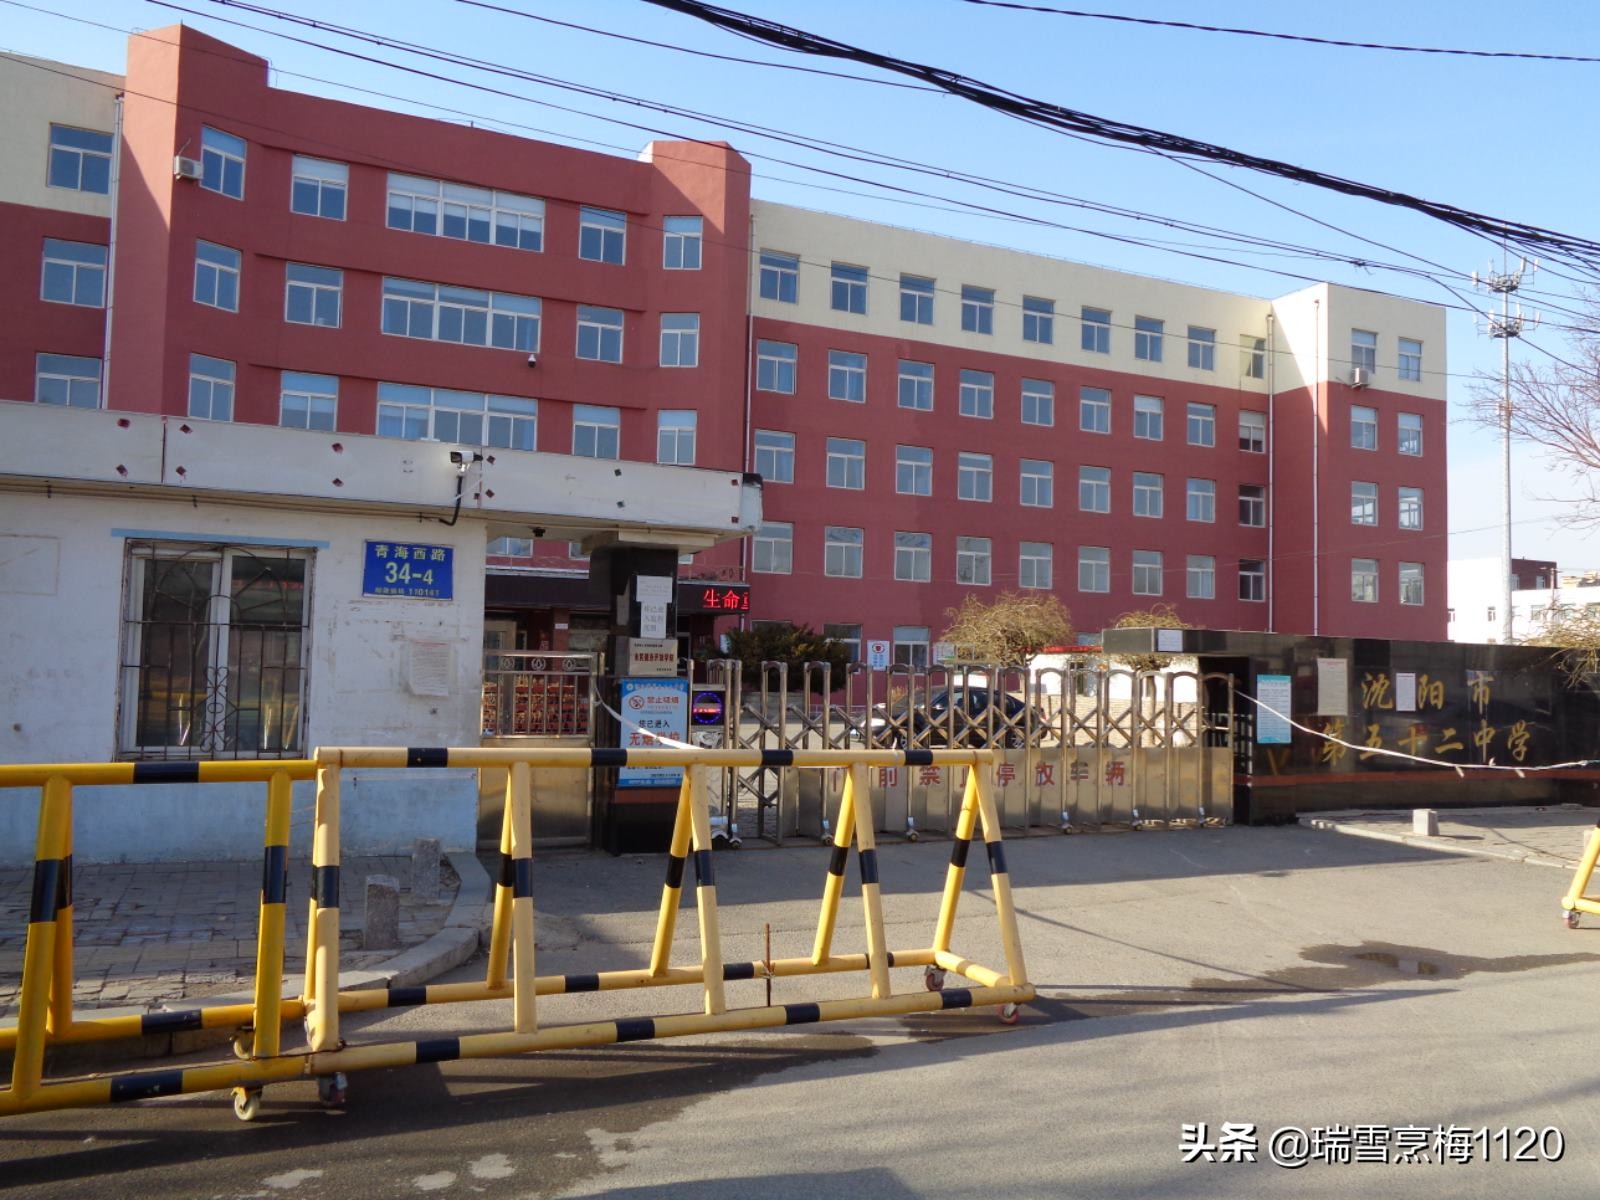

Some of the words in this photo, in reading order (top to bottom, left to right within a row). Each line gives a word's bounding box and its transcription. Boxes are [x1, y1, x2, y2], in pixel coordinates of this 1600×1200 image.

[374, 544, 445, 562] 青海西路
[385, 562, 433, 585] 34-4
[1360, 671, 1494, 715] 沈阳市
[1321, 718, 1533, 766] 第五十二中学
